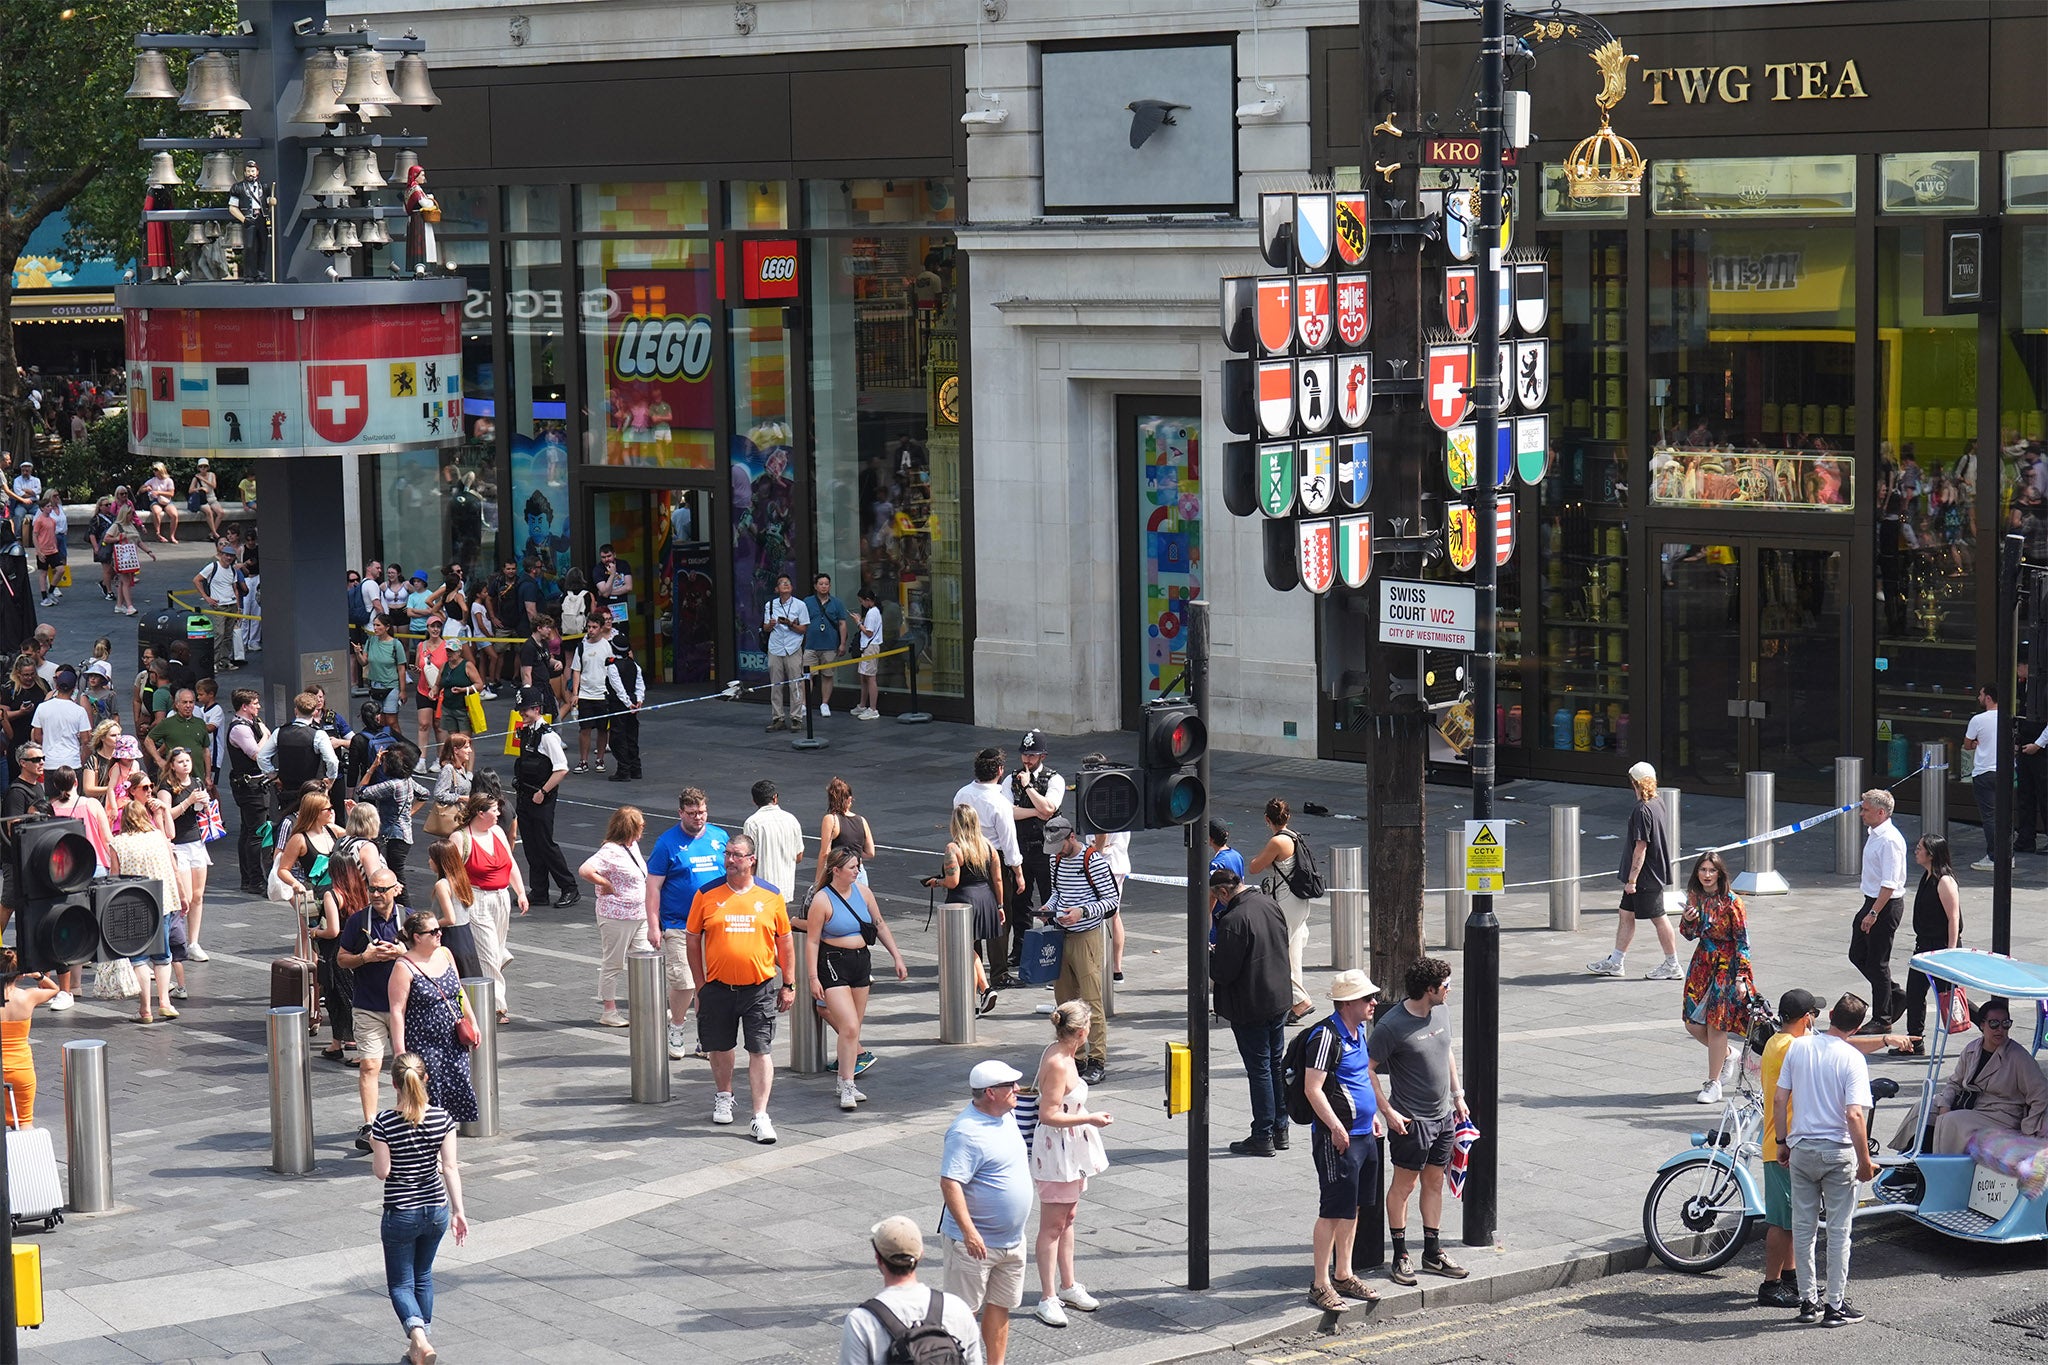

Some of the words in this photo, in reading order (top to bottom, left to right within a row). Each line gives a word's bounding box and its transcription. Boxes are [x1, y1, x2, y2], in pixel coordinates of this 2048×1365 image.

[1642, 65, 1751, 105] TWG
[1764, 59, 1869, 101] TEA
[1739, 184, 1766, 195] TWG
[1915, 180, 1945, 192] TWG
[762, 256, 796, 281] LEGO
[1957, 263, 1974, 275] TWG
[52, 307, 82, 316] COSTA
[618, 318, 711, 376] LEGO
[362, 433, 396, 442] Switzerland
[1389, 586, 1426, 604] SWISS
[1389, 604, 1427, 622] COURT
[1430, 608, 1455, 625] WC2
[1389, 627, 1404, 638] CITY
[1405, 629, 1415, 639] OF
[1416, 630, 1465, 644] WESTMINSTER
[689, 854, 717, 864] UNIBET
[725, 914, 756, 923] UNIBET
[1977, 1179, 1996, 1191] GLOW
[1987, 1192, 2002, 1203] TAXI
